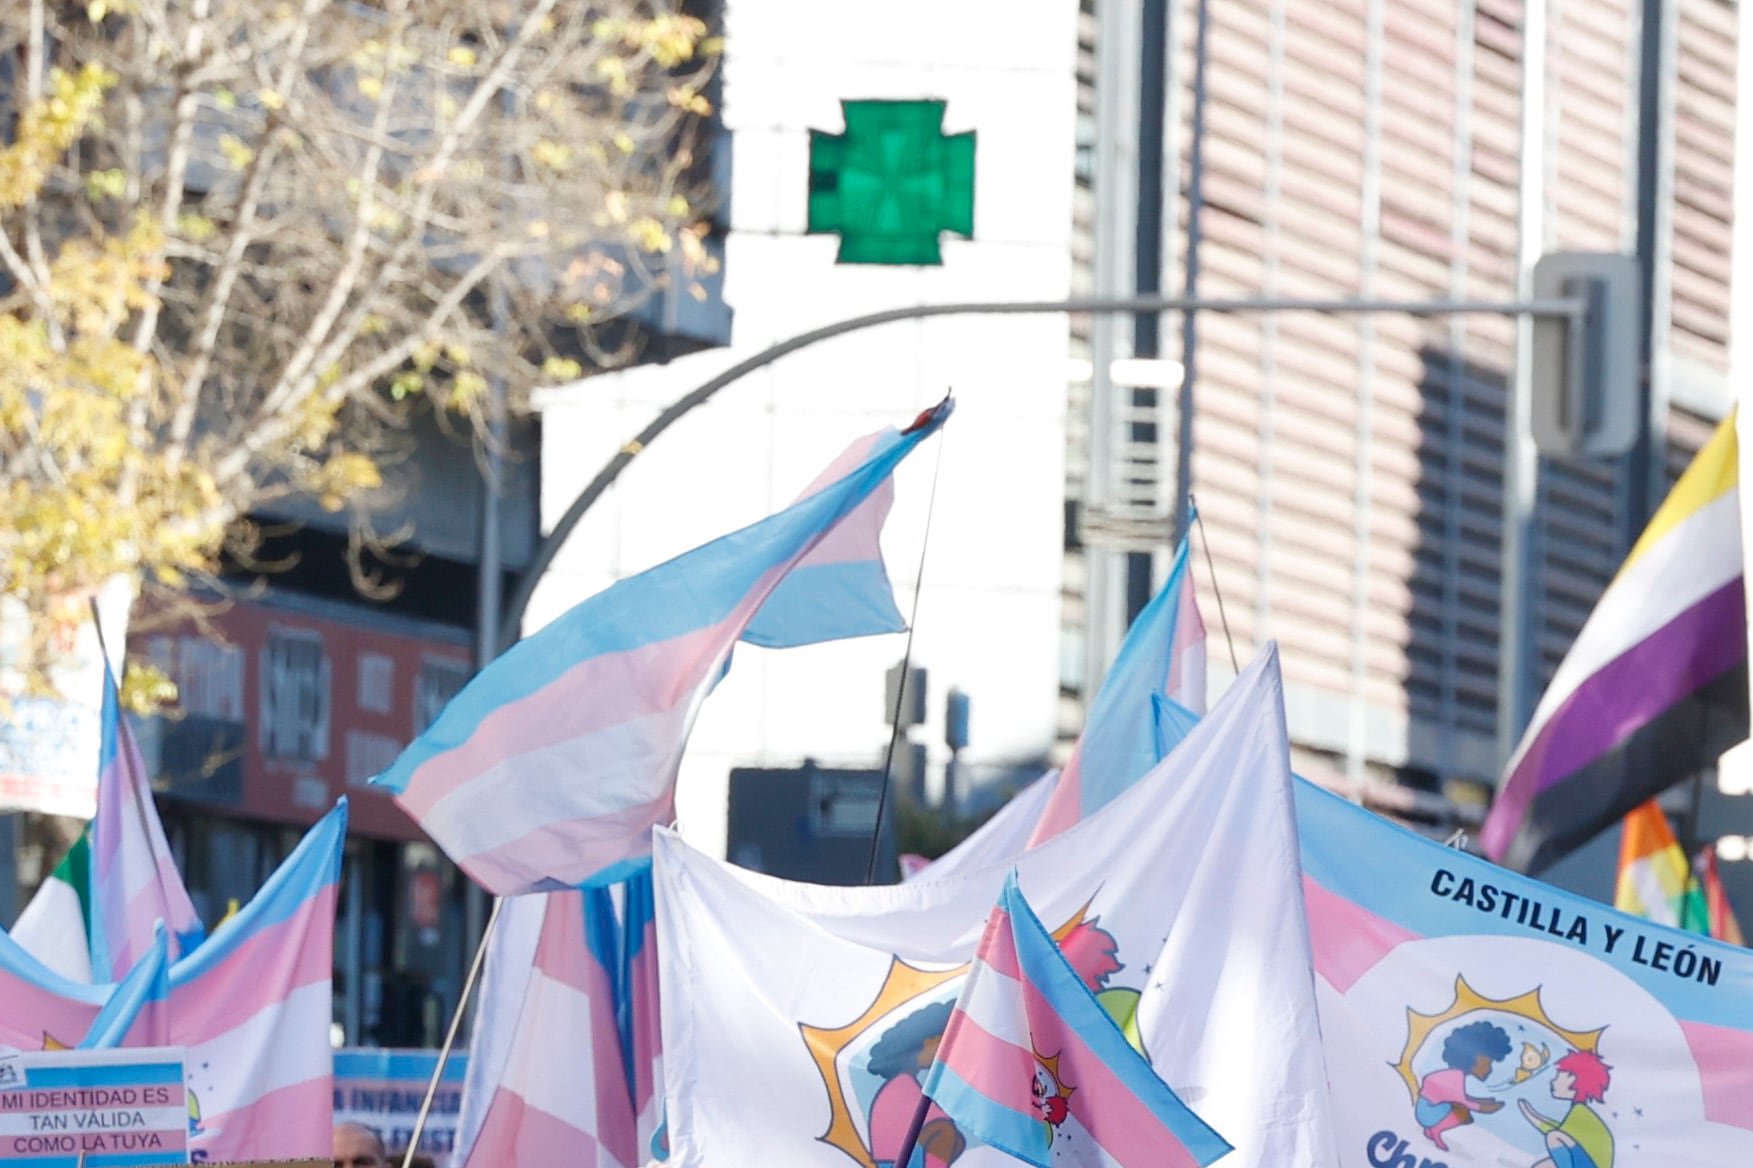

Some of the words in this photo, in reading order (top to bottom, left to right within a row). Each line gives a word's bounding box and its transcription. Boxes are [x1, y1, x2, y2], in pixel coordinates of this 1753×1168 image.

[1430, 869, 1588, 945] CASTILLA
[1604, 924, 1624, 953] Y
[1632, 936, 1722, 987] LEÓN
[2, 1093, 23, 1109] MI
[29, 1089, 137, 1109] IDENTIDAD
[143, 1087, 169, 1104] ES
[30, 1114, 68, 1130] TAN
[73, 1109, 146, 1128] VÁLIDA
[14, 1136, 76, 1154] COMO
[81, 1135, 105, 1151] LA
[109, 1132, 162, 1149] TUYA
